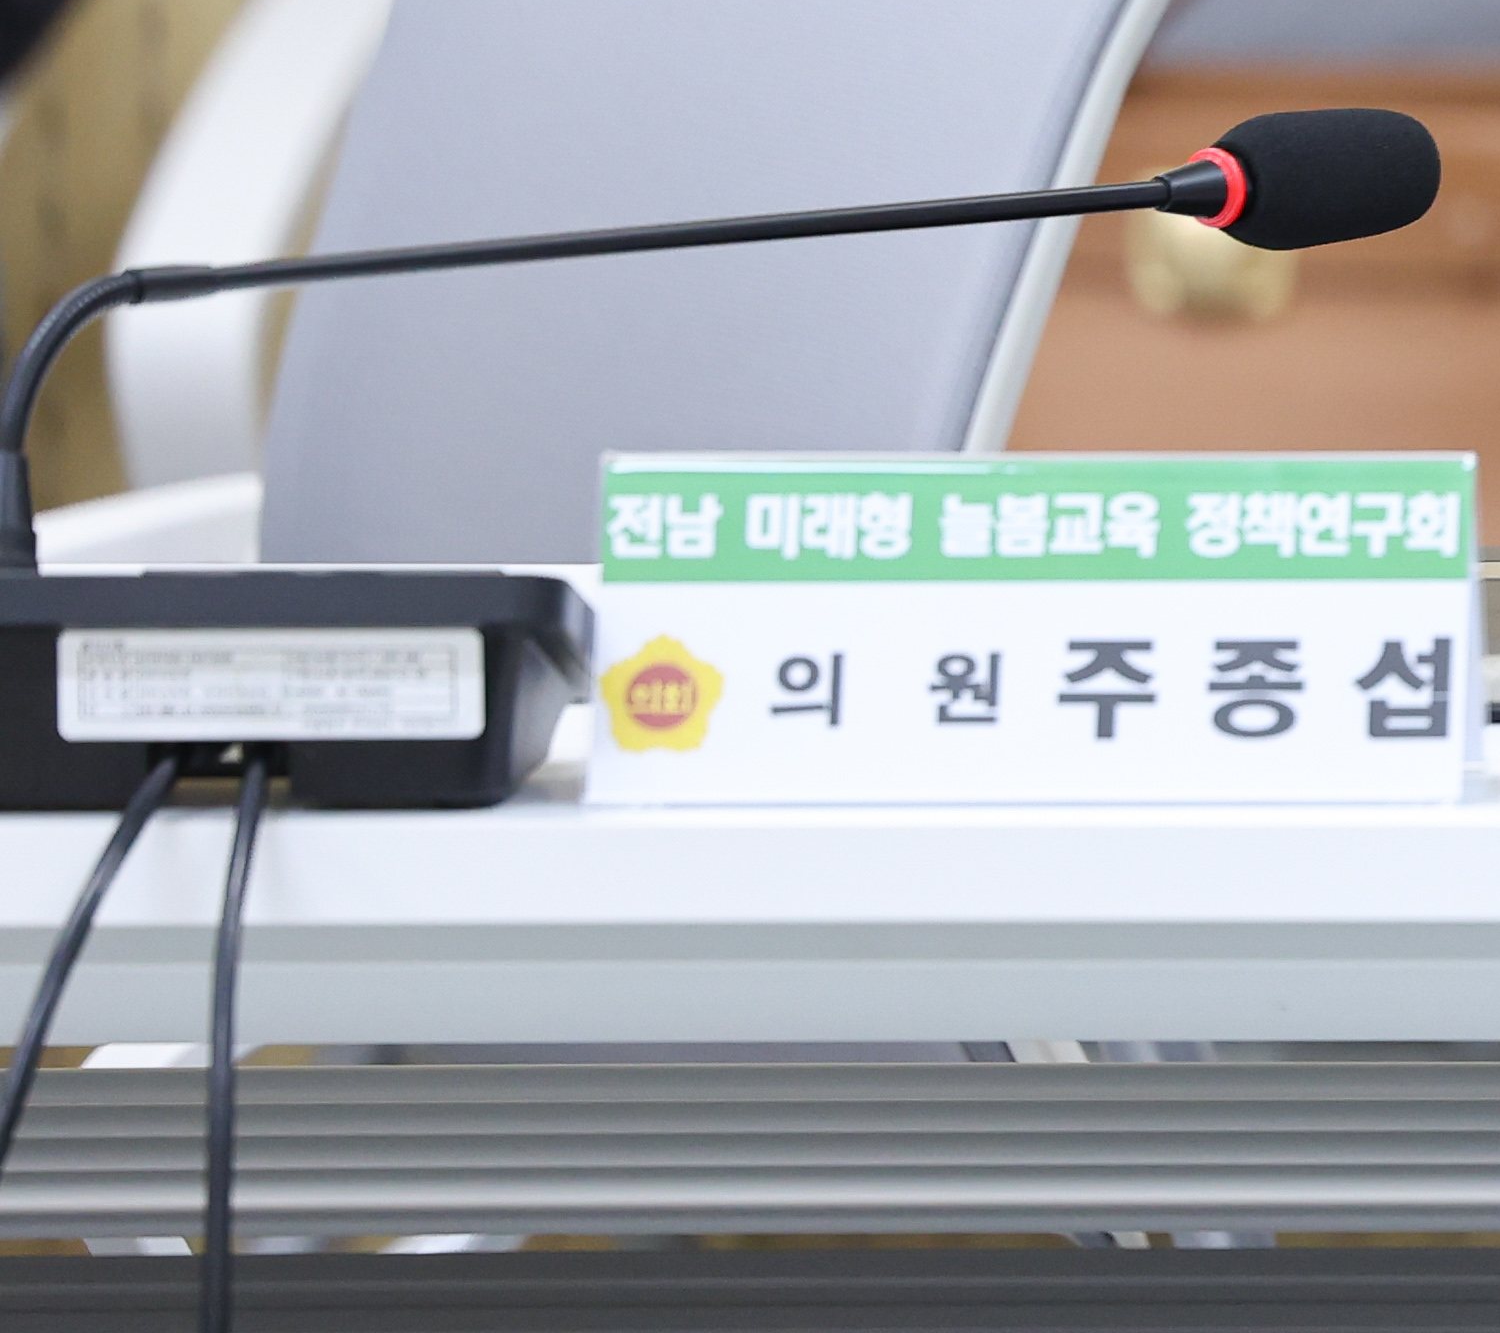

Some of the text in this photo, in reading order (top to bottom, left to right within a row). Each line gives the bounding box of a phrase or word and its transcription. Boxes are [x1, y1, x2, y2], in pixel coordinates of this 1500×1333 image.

[606, 490, 1461, 560] 전남 미래형 늘봄교육 정책연구회
